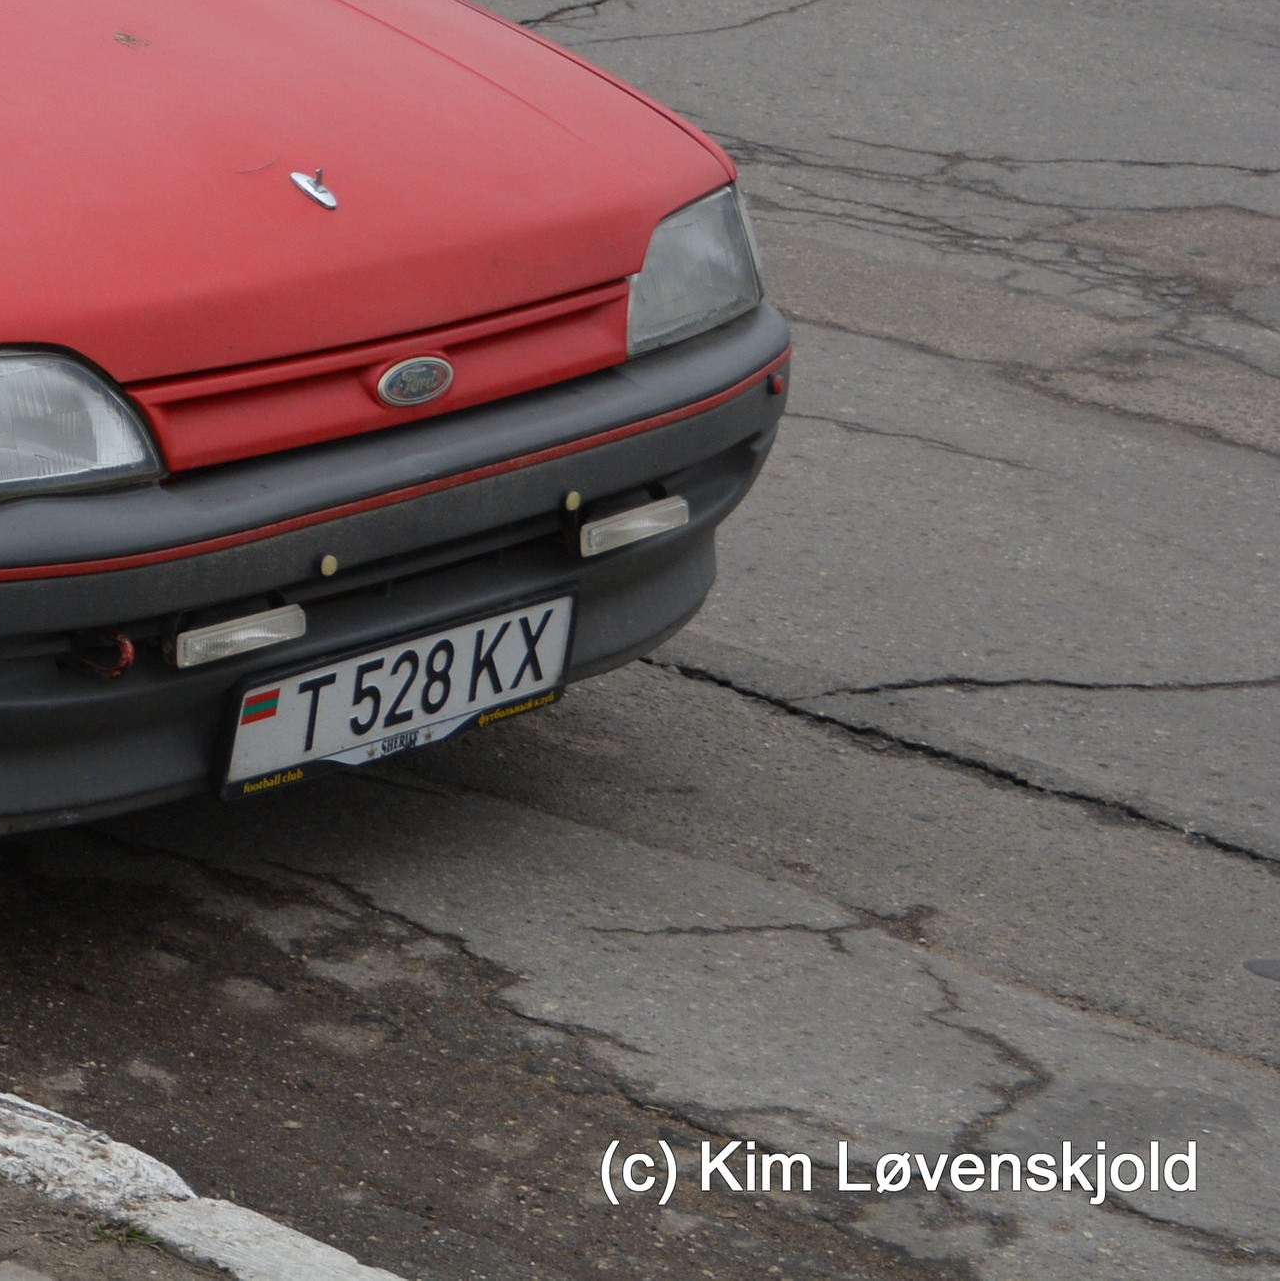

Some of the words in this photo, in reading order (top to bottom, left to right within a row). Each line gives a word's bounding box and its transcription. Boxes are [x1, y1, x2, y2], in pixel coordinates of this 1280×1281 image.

[298, 672, 337, 753] T
[349, 638, 455, 736] 528
[467, 608, 554, 703] KX
[243, 773, 281, 794] football
[282, 769, 304, 785] club
